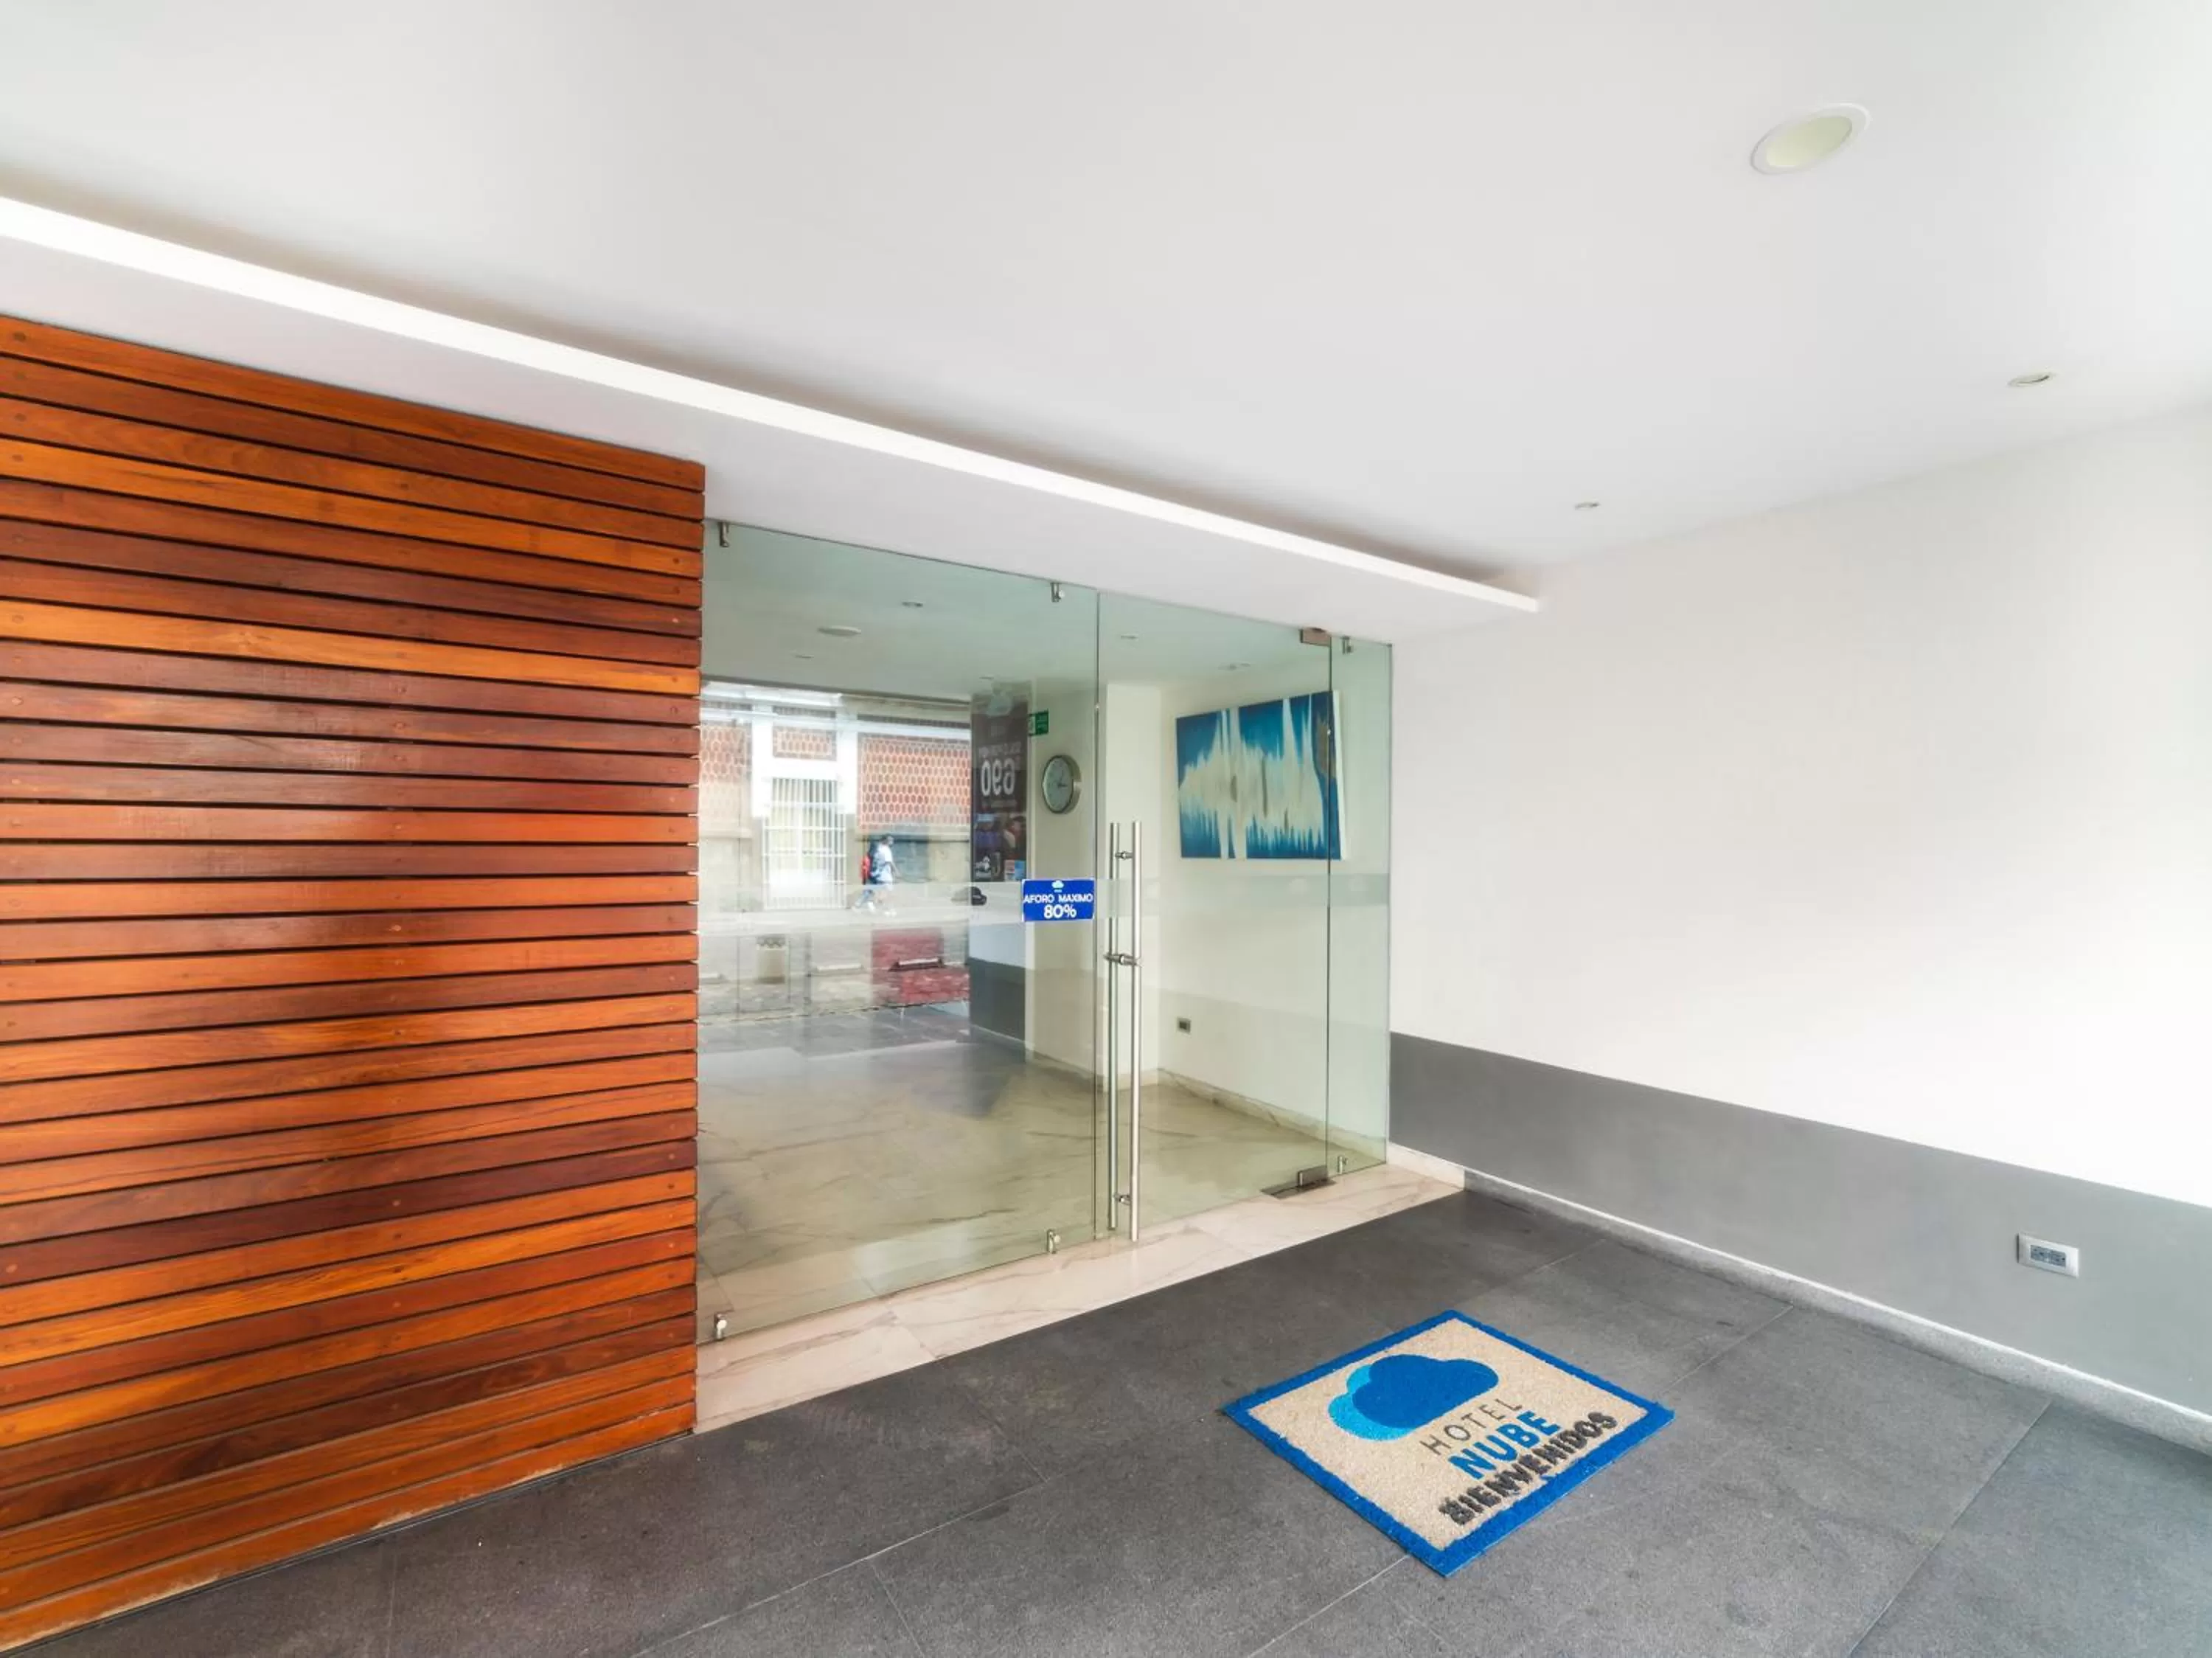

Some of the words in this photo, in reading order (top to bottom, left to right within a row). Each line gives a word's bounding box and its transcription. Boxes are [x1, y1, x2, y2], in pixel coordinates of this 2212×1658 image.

[1023, 894, 1054, 903] AFORO
[1058, 893, 1093, 903] MAXIMO
[1043, 904, 1077, 919] 80%
[1419, 1398, 1523, 1456] HOTEL
[1448, 1409, 1561, 1480] NUBE
[1439, 1412, 1618, 1525] BIENVENIDOS
